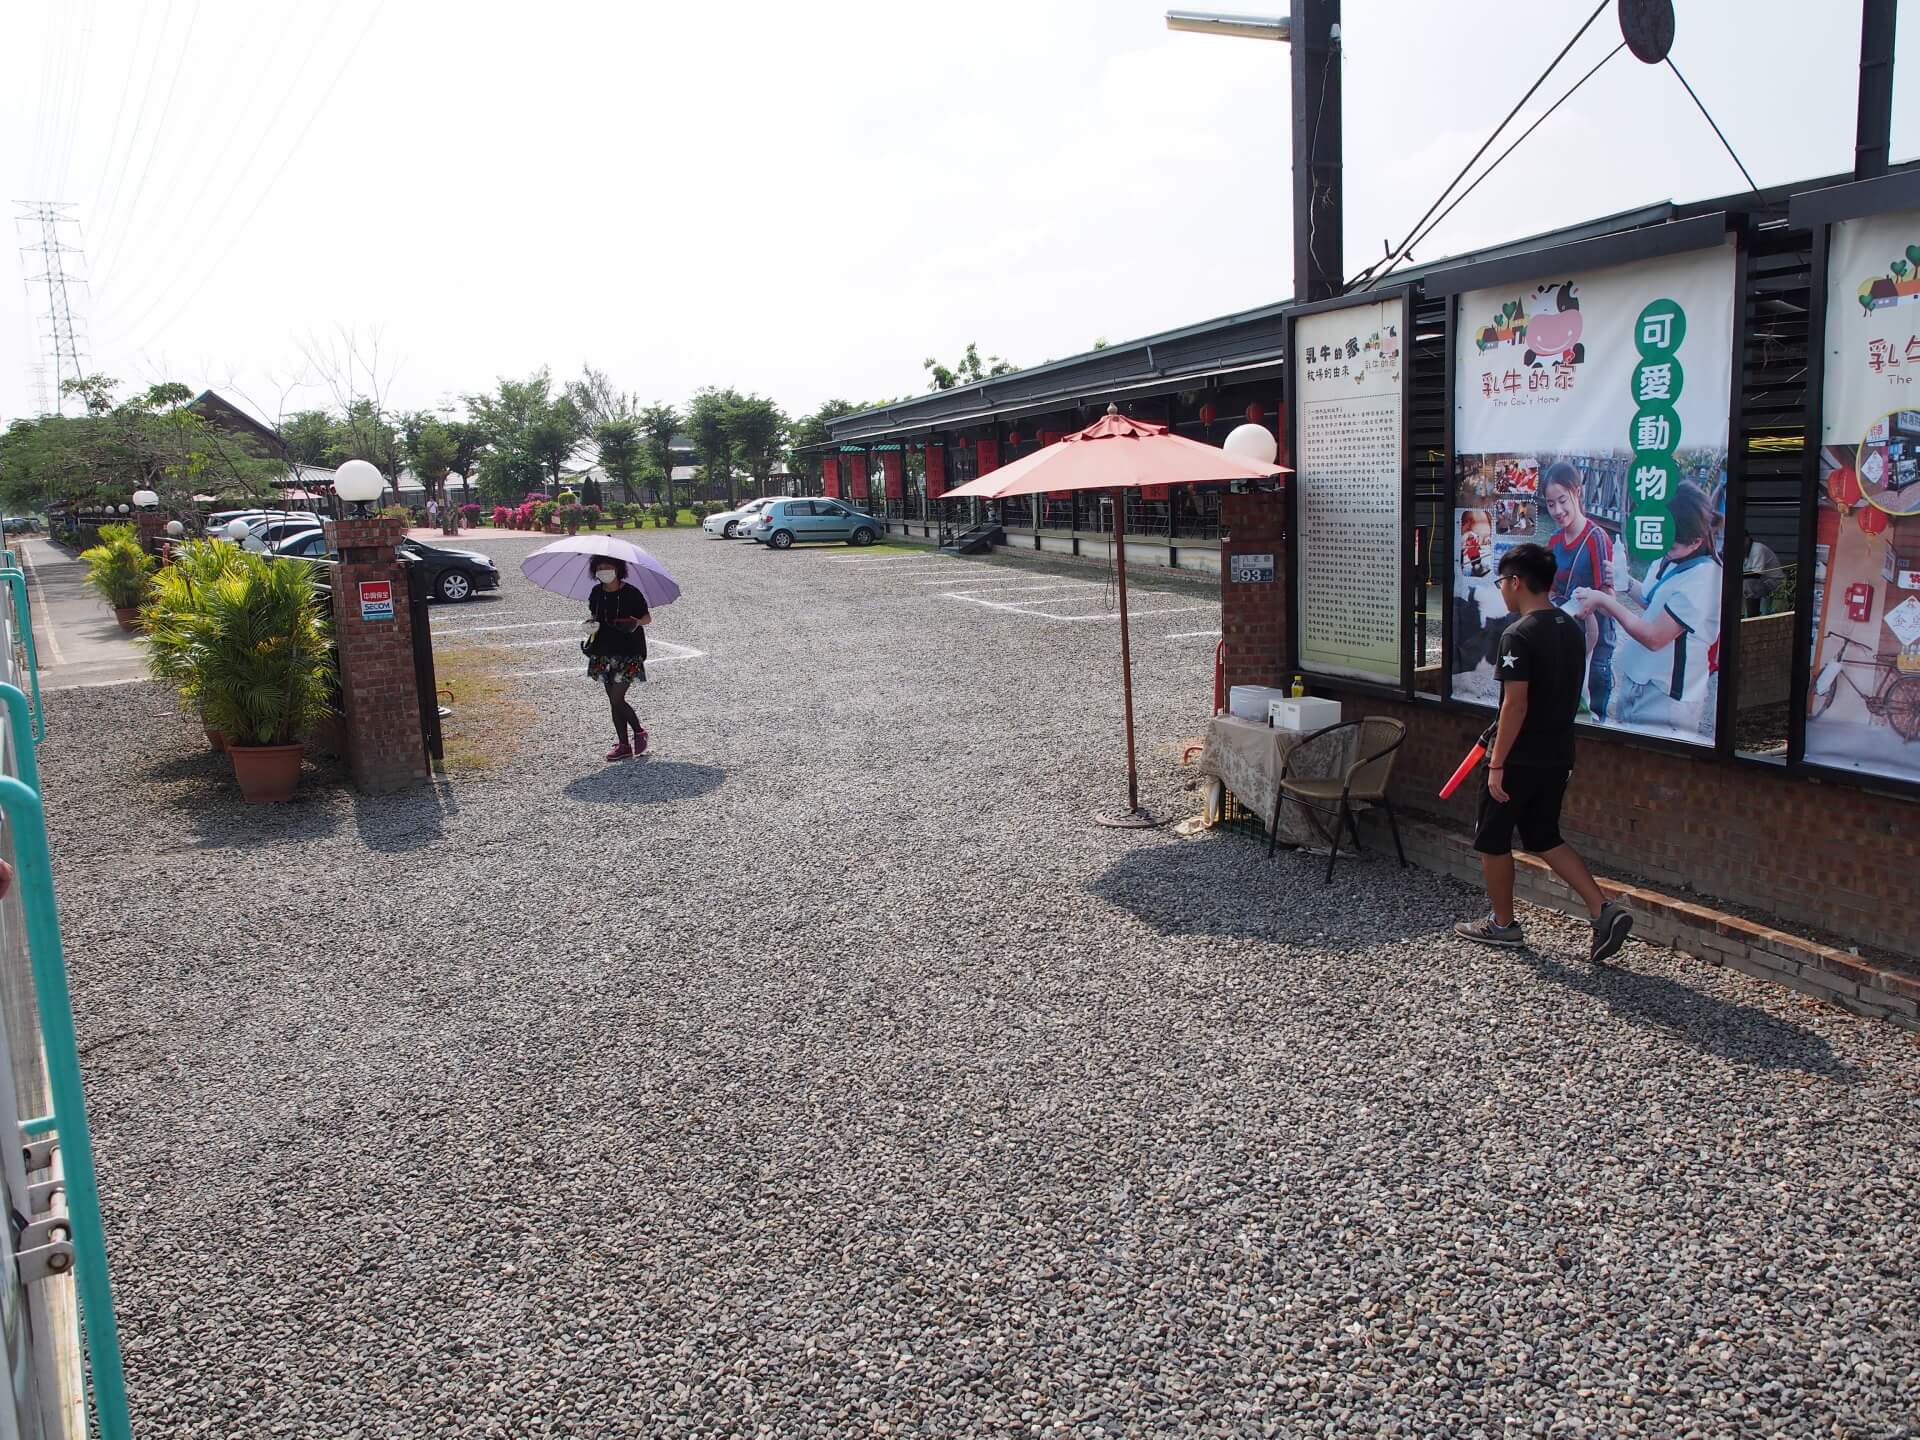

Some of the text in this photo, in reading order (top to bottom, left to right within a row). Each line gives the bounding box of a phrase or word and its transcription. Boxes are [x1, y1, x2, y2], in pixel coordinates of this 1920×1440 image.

[1306, 337, 1360, 364] 乳牛的家
[1307, 365, 1350, 382] 牧場的由來
[1481, 362, 1576, 399] 乳牛的家
[1887, 375, 1913, 385] The
[1493, 399, 1508, 407] The
[1537, 395, 1560, 405] Home
[1633, 313, 1675, 550] 可愛動物區
[1240, 569, 1262, 582] 93
[364, 603, 390, 611] SECOM
